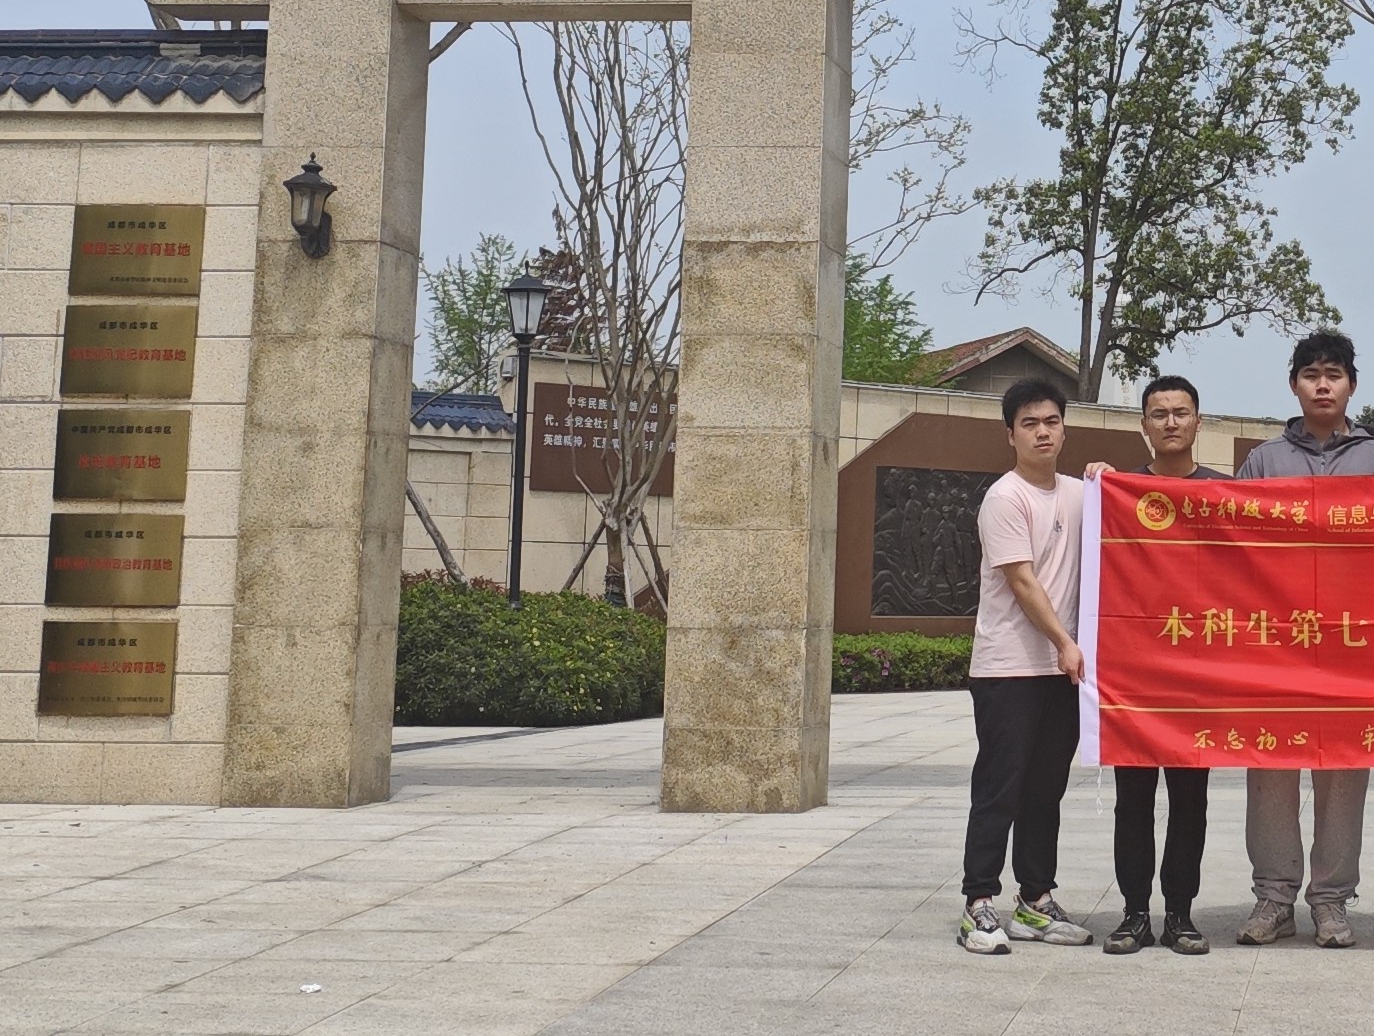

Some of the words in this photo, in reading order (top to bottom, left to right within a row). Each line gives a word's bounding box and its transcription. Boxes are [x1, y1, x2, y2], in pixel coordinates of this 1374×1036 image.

[1181, 495, 1309, 524] 电子科技大学
[1193, 727, 1309, 751] 不忘初心
